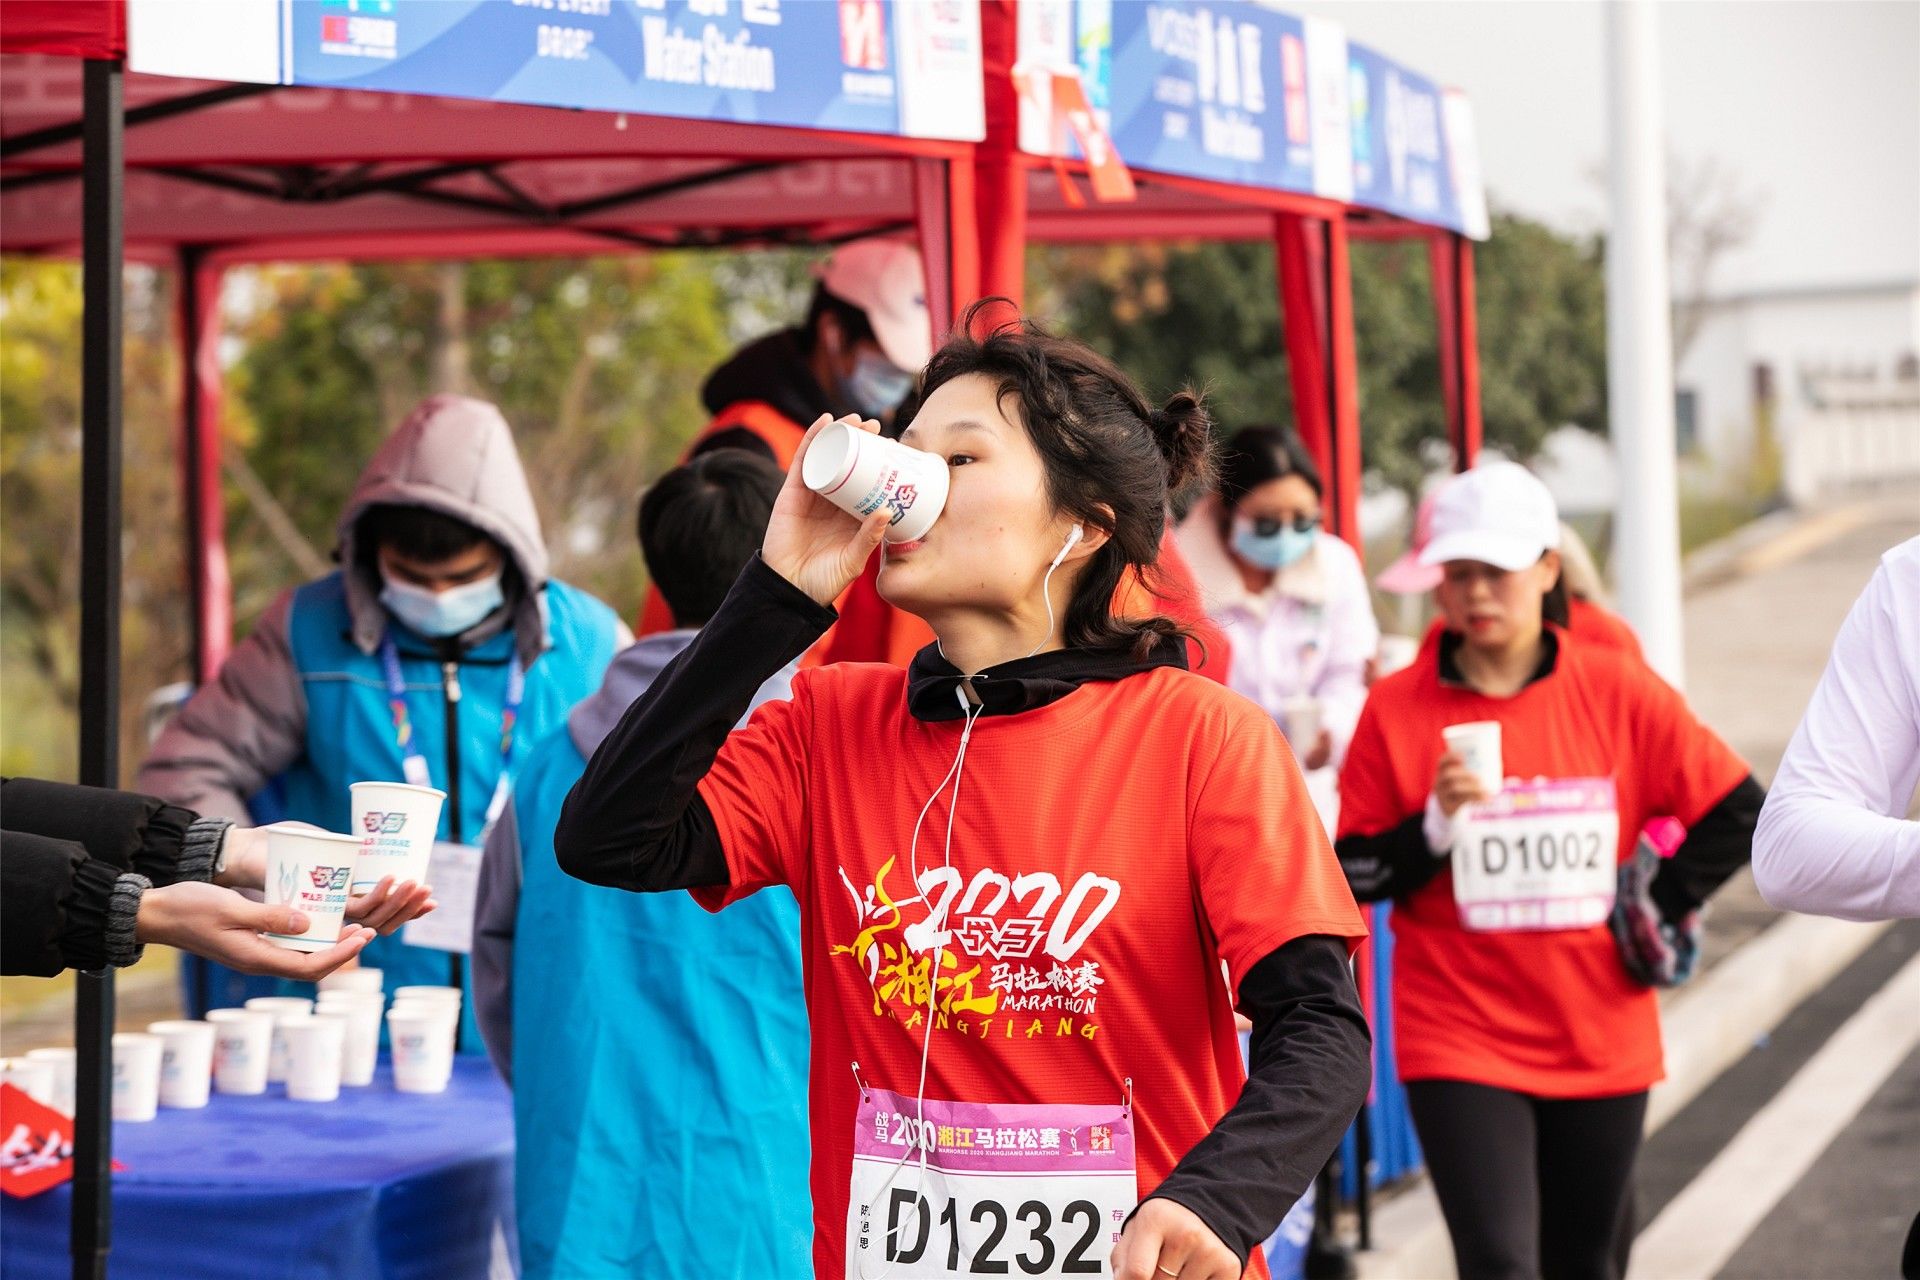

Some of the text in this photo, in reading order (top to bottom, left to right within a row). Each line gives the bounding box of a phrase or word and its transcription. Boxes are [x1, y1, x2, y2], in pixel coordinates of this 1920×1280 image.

[1481, 832, 1601, 874] D1002
[301, 892, 323, 902] WAR
[878, 941, 999, 1016] 湘江
[988, 959, 1105, 998] 马拉松赛
[1000, 994, 1097, 1015] MARATHON
[875, 1111, 889, 1143] 战马
[938, 1148, 968, 1156] WARHORSE
[1024, 1149, 1060, 1157] MARATHON
[886, 1187, 1102, 1275] D1232
